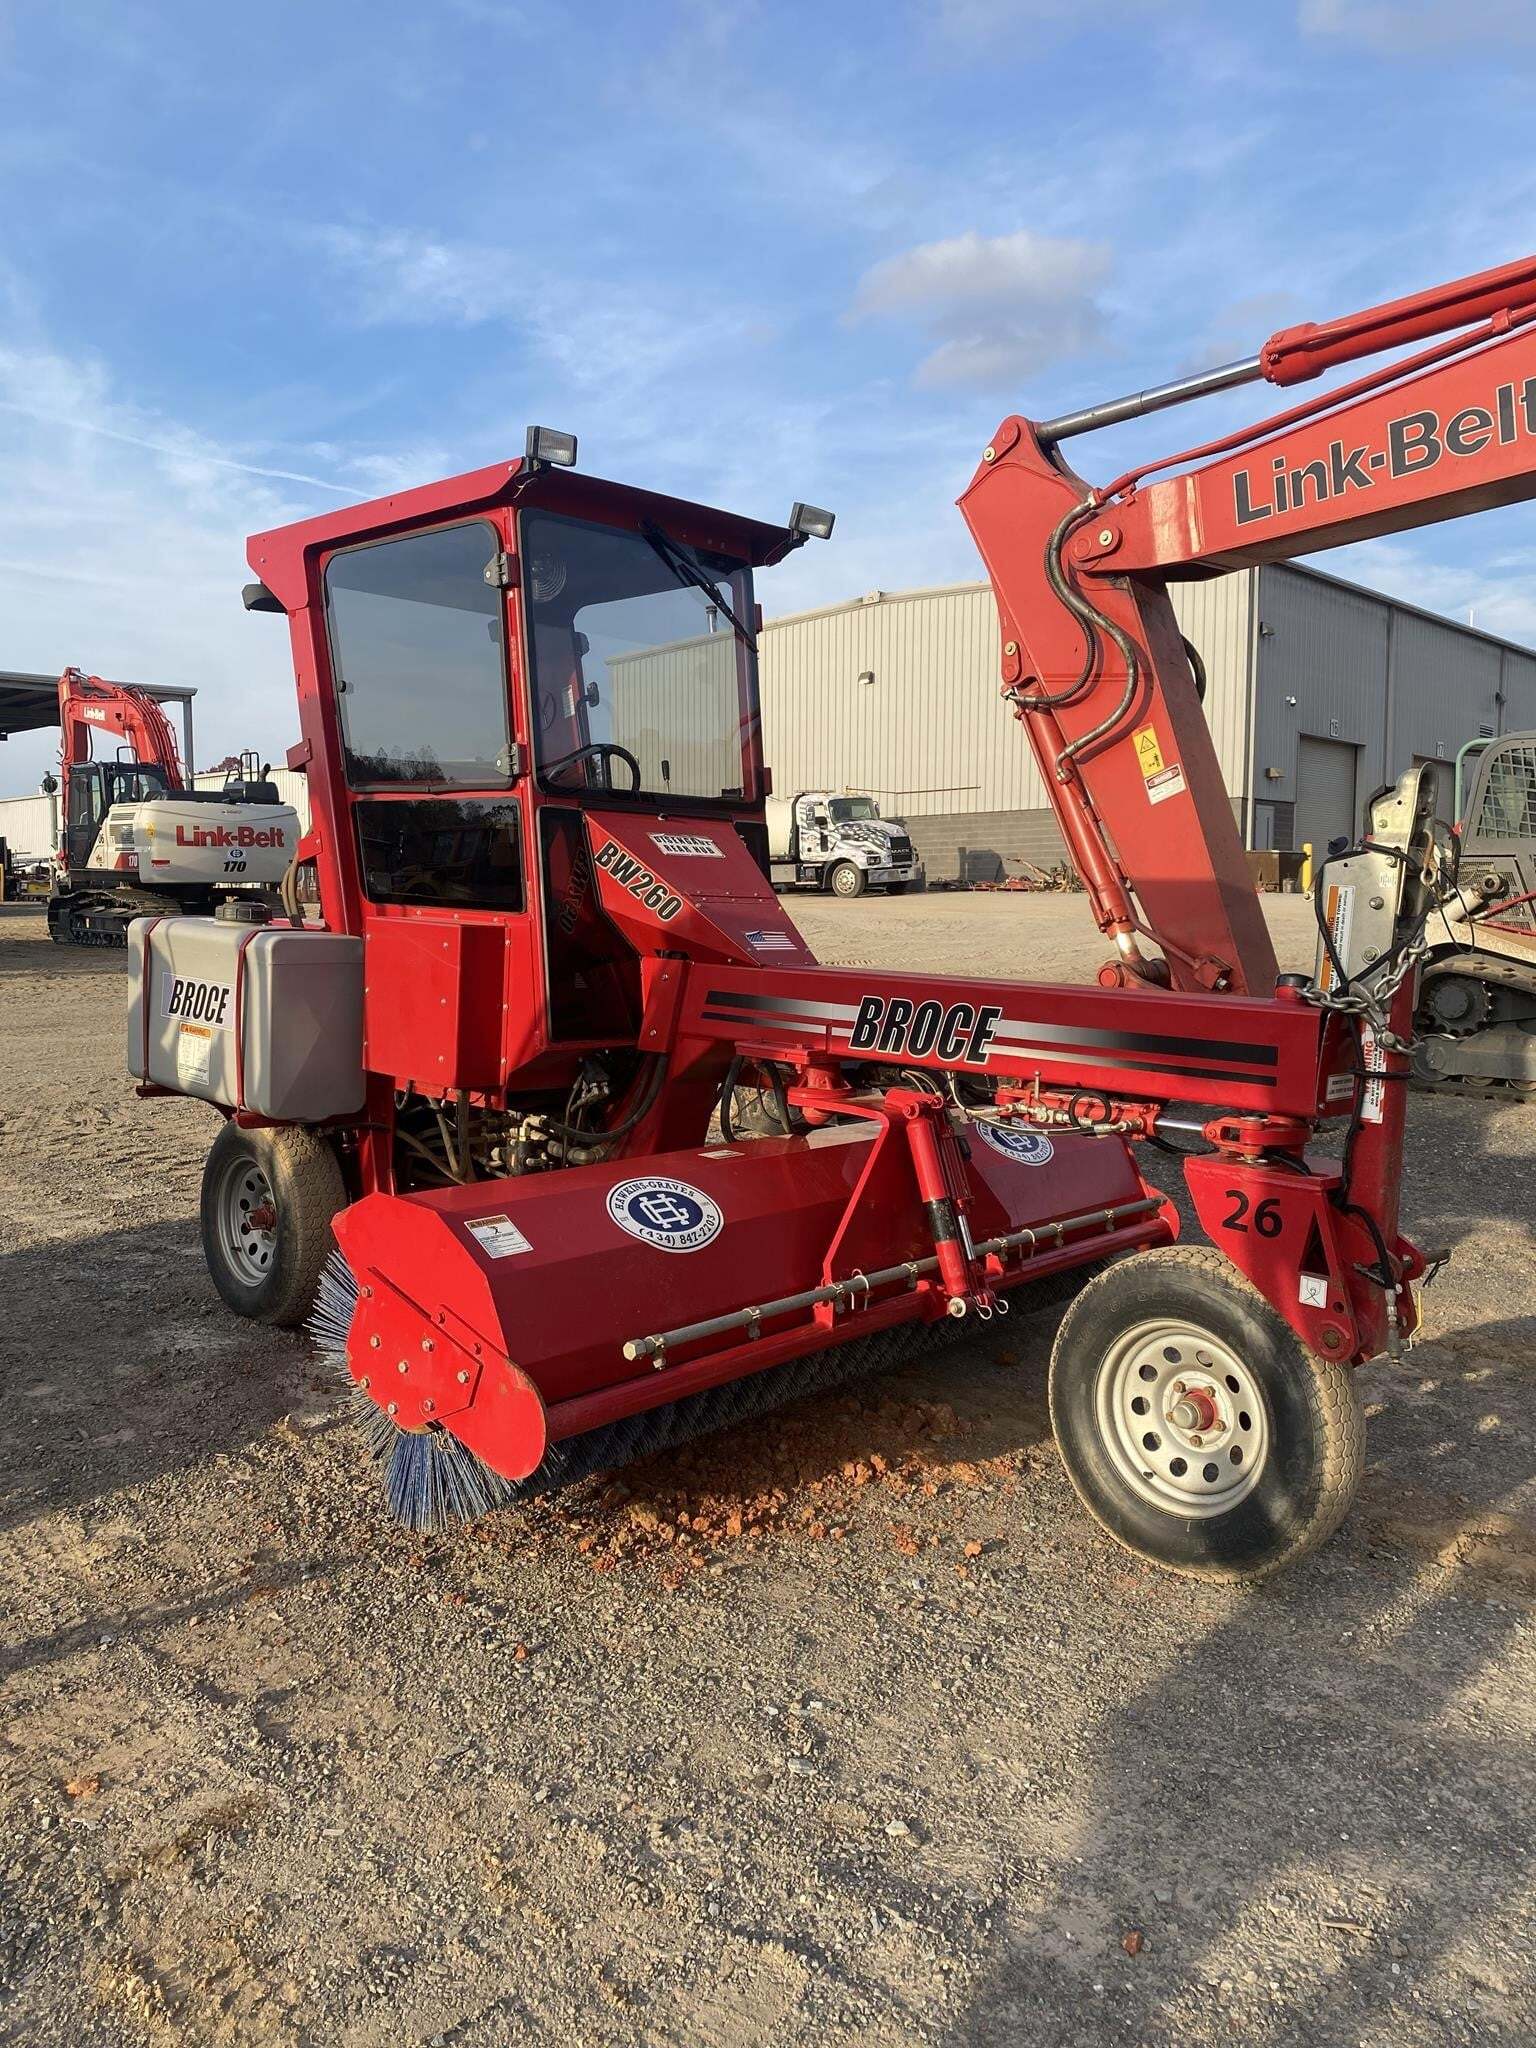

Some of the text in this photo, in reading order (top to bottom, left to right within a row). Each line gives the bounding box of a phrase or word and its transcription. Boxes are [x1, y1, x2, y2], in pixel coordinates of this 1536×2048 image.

[1233, 376, 1536, 526] Link-Belt
[176, 825, 285, 847] Link-Belt
[128, 855, 138, 867] 170
[223, 861, 246, 872] 170
[594, 840, 683, 921] BW260
[169, 979, 229, 1024] BROCE
[848, 995, 1003, 1065] BROCE
[614, 1181, 695, 1211] HAWKINS-GRAVES
[1222, 1189, 1283, 1238] 26
[639, 1214, 716, 1246] (434) 847-7703
